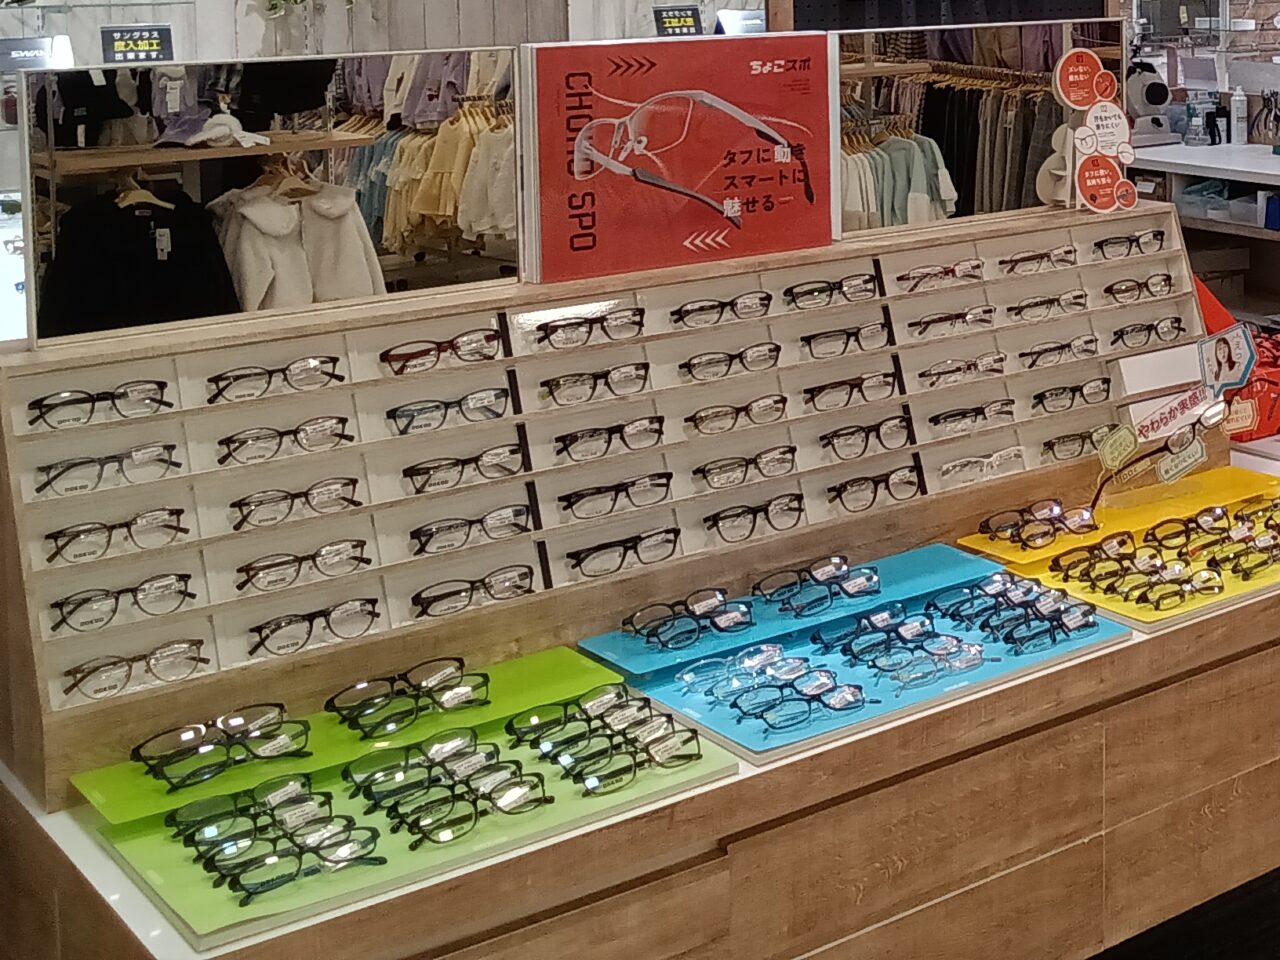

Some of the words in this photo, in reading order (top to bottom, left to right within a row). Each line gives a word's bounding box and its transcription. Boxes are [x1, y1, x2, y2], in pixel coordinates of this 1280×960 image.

[113, 40, 161, 51] 度入加工
[114, 52, 164, 61] 出来ます。
[750, 56, 812, 75] ちょこスポ
[722, 143, 806, 168] タフに動き
[723, 168, 806, 192] スマートに
[567, 191, 598, 253] SPO
